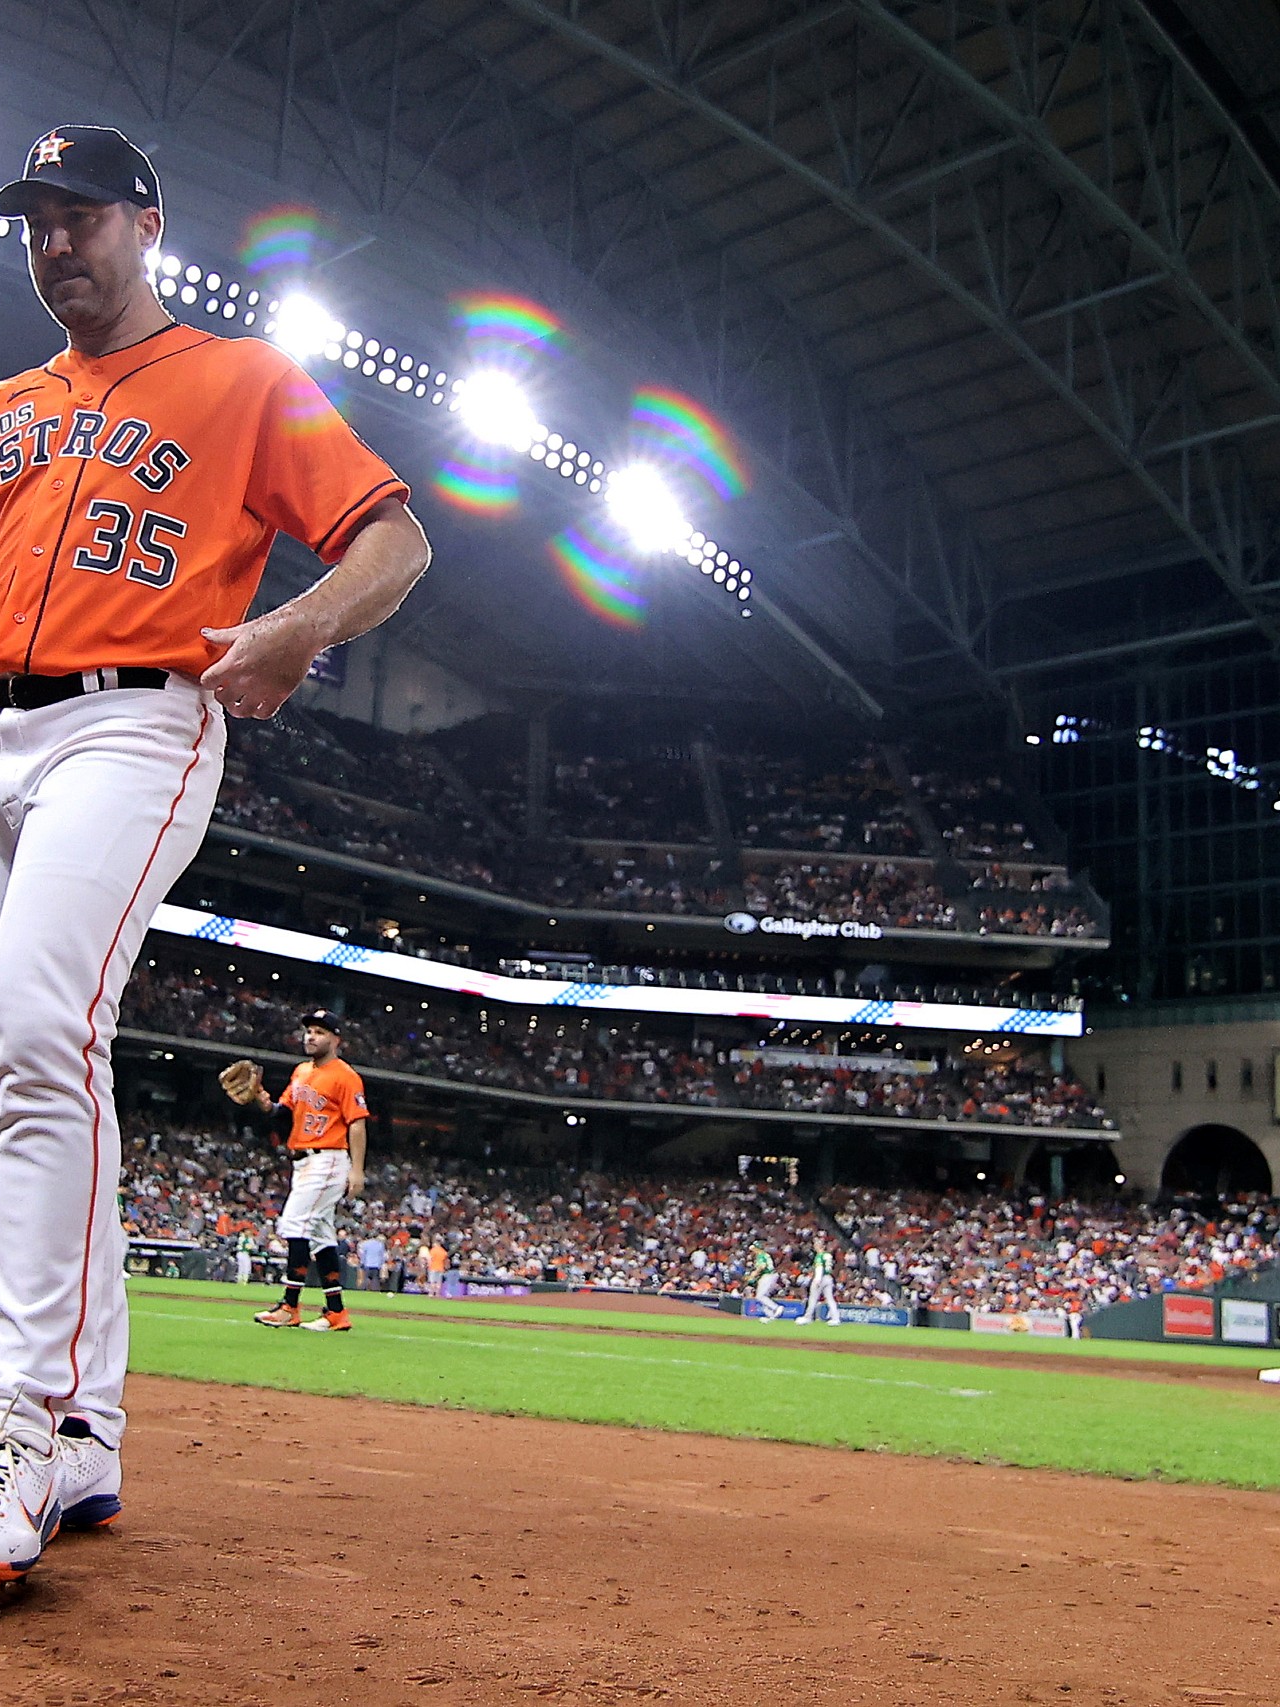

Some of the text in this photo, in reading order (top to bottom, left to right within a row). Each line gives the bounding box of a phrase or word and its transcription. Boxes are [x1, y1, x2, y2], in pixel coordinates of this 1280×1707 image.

[72, 499, 188, 590] 35
[759, 916, 883, 940] Gallagher Club
[304, 1112, 329, 1137] 27
